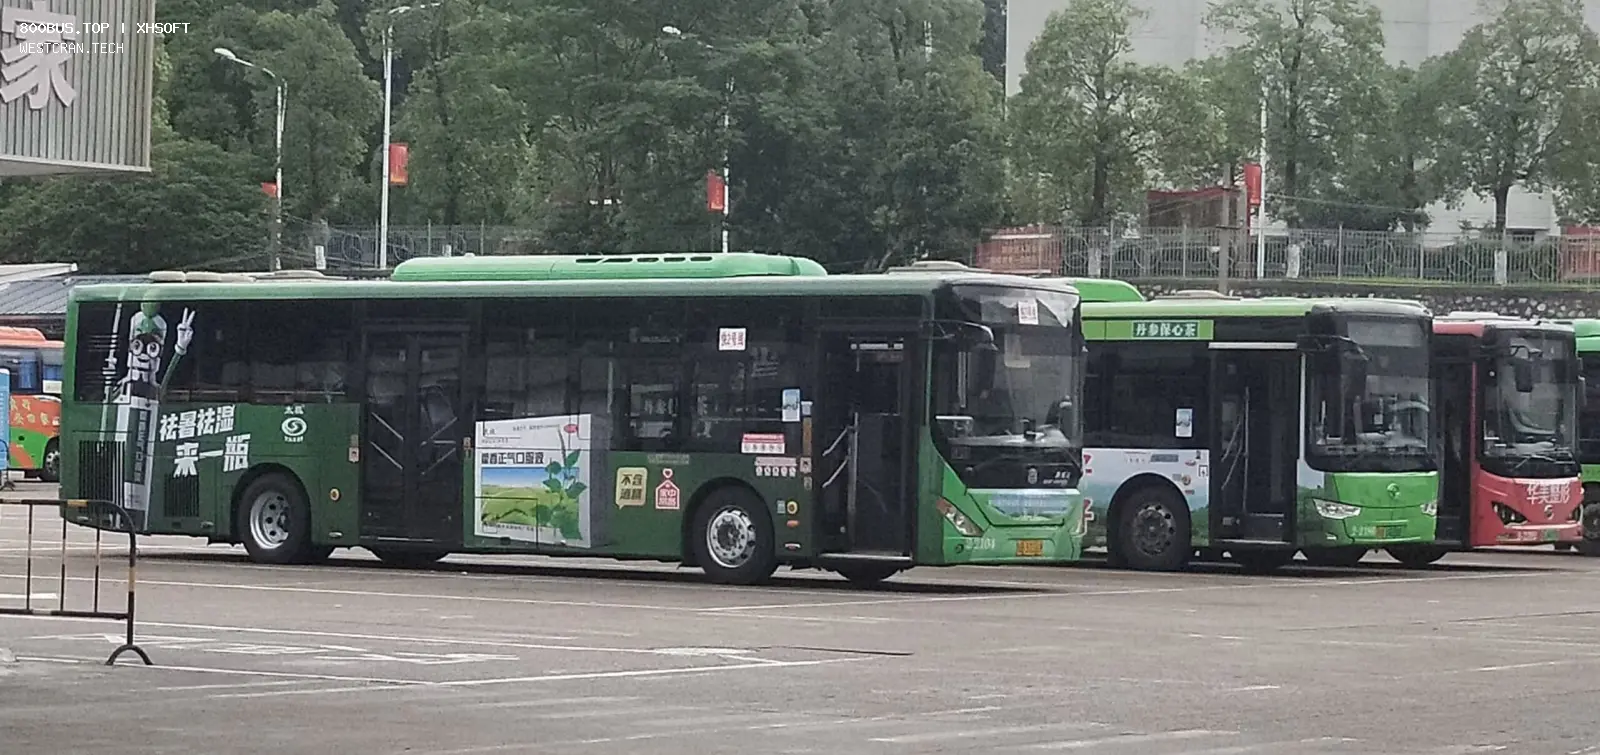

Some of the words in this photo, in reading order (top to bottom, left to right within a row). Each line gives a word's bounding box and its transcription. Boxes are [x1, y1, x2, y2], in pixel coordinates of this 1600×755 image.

[0, 0, 76, 110] 家
[1136, 322, 1197, 337] 丹参保心茶
[160, 404, 236, 441] 祛暑祛湿
[173, 433, 251, 478] 来一瓶
[1526, 482, 1570, 505] 华美整形
